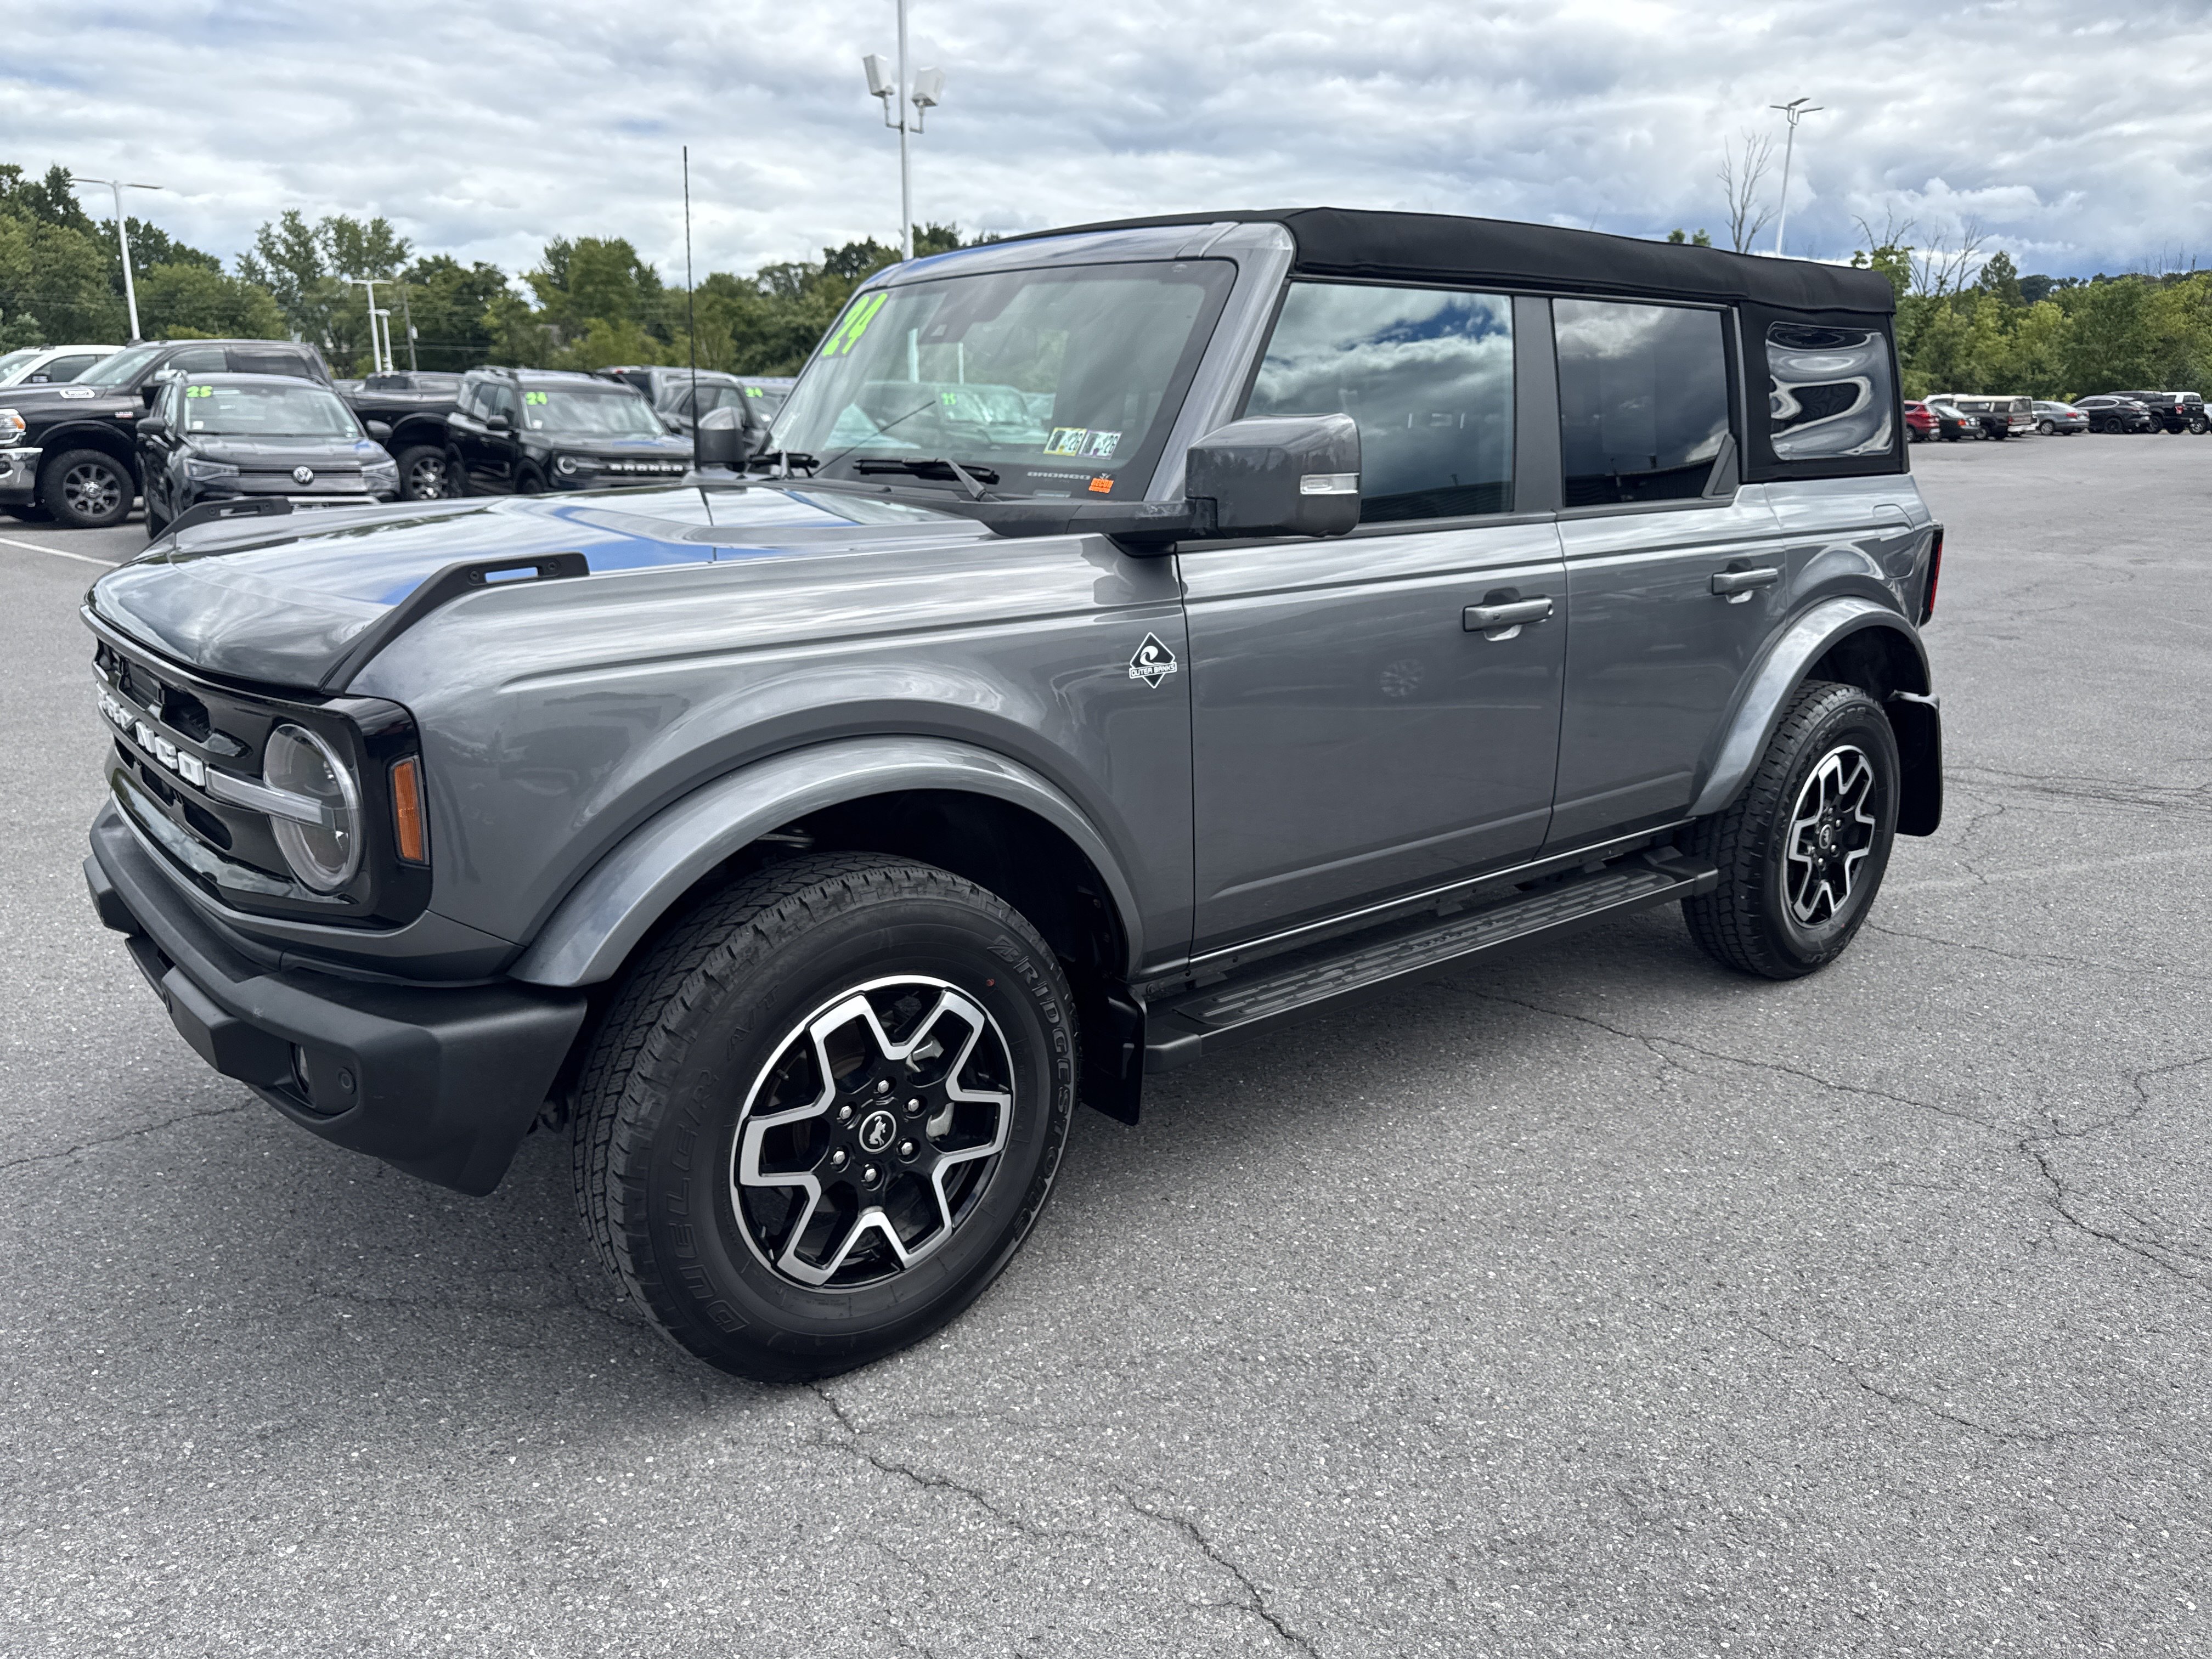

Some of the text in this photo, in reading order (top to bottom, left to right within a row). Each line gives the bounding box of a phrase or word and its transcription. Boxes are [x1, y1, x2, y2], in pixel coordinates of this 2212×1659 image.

[822, 292, 887, 357] 24
[186, 386, 212, 398] 25
[1026, 471, 1091, 480] BRONCO
[1131, 664, 1175, 676] OUTER BANKS
[986, 934, 1071, 1241] BRIDGESTONE
[666, 1066, 750, 1334] DUELER
